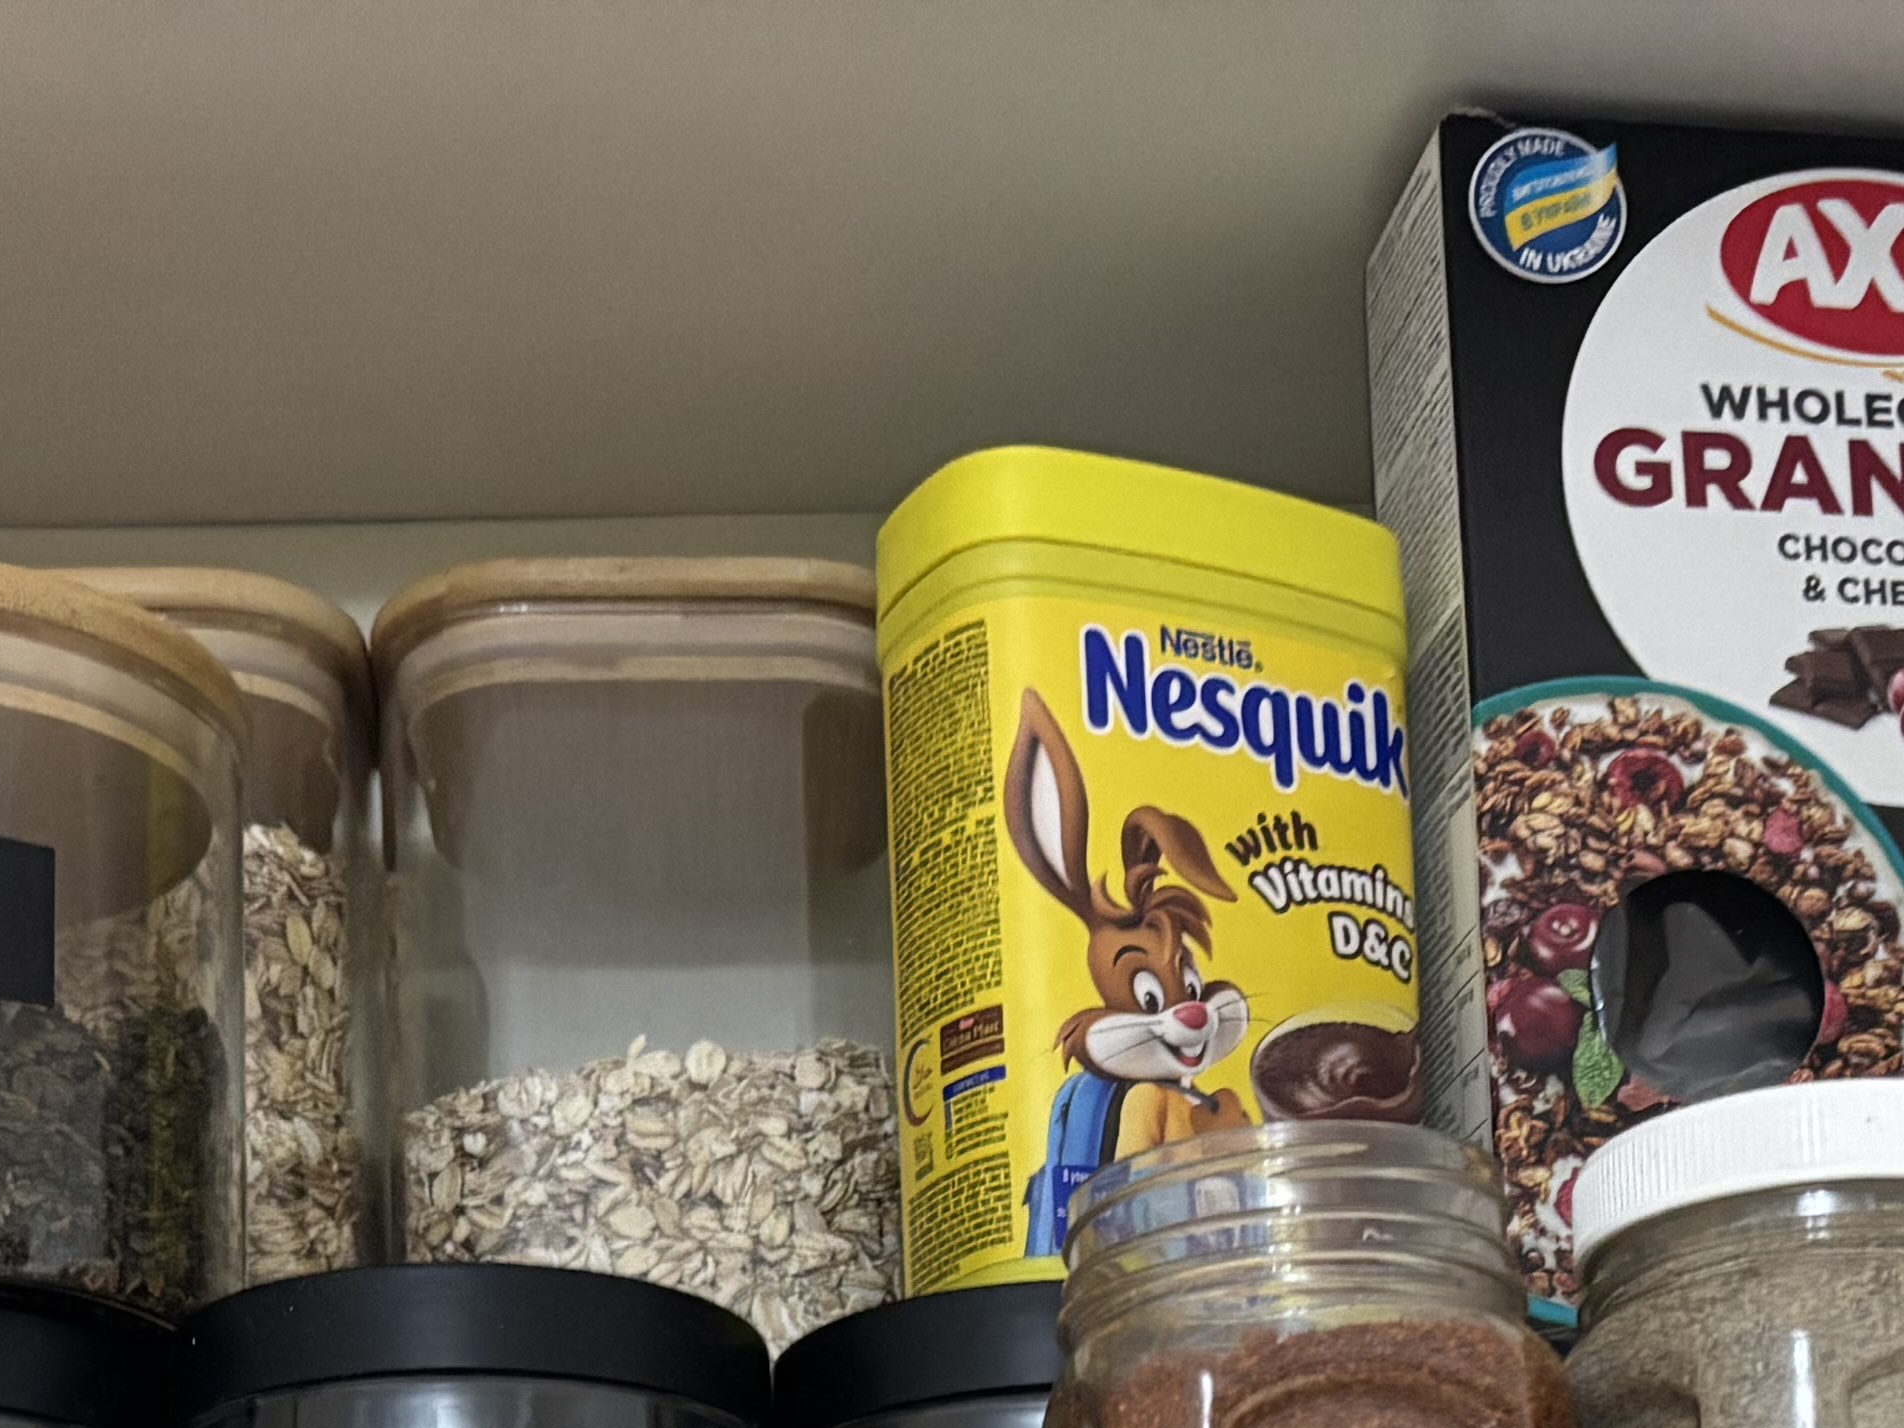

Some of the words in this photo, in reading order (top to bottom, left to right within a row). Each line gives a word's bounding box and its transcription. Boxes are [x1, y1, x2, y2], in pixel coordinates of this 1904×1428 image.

[1519, 247, 1543, 271] IN
[1803, 575, 1826, 603] &
[1081, 625, 1409, 799] Nesquik
[1225, 810, 1319, 866] with
